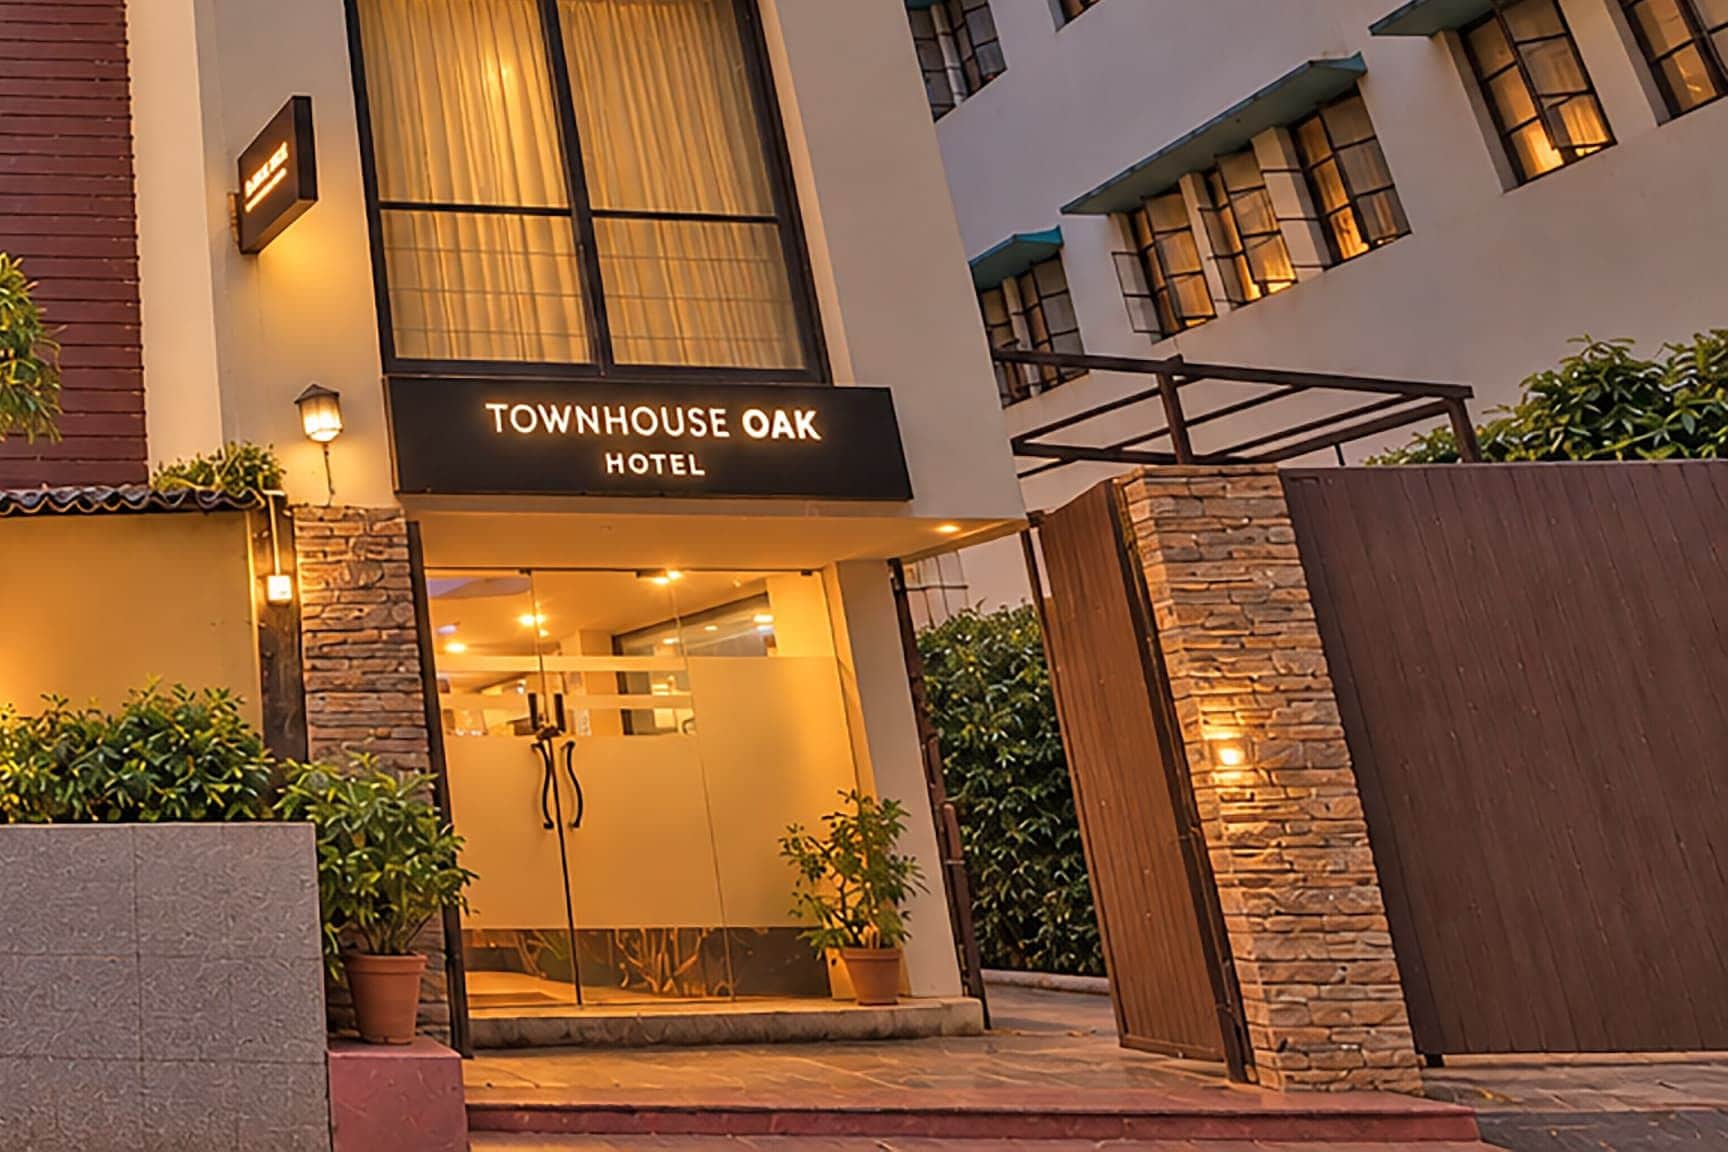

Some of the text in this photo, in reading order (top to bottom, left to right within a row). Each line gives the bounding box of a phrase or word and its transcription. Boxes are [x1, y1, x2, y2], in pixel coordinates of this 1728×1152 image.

[484, 402, 822, 441] TOWNHOUSE OAK
[604, 451, 707, 477] HOTEL
